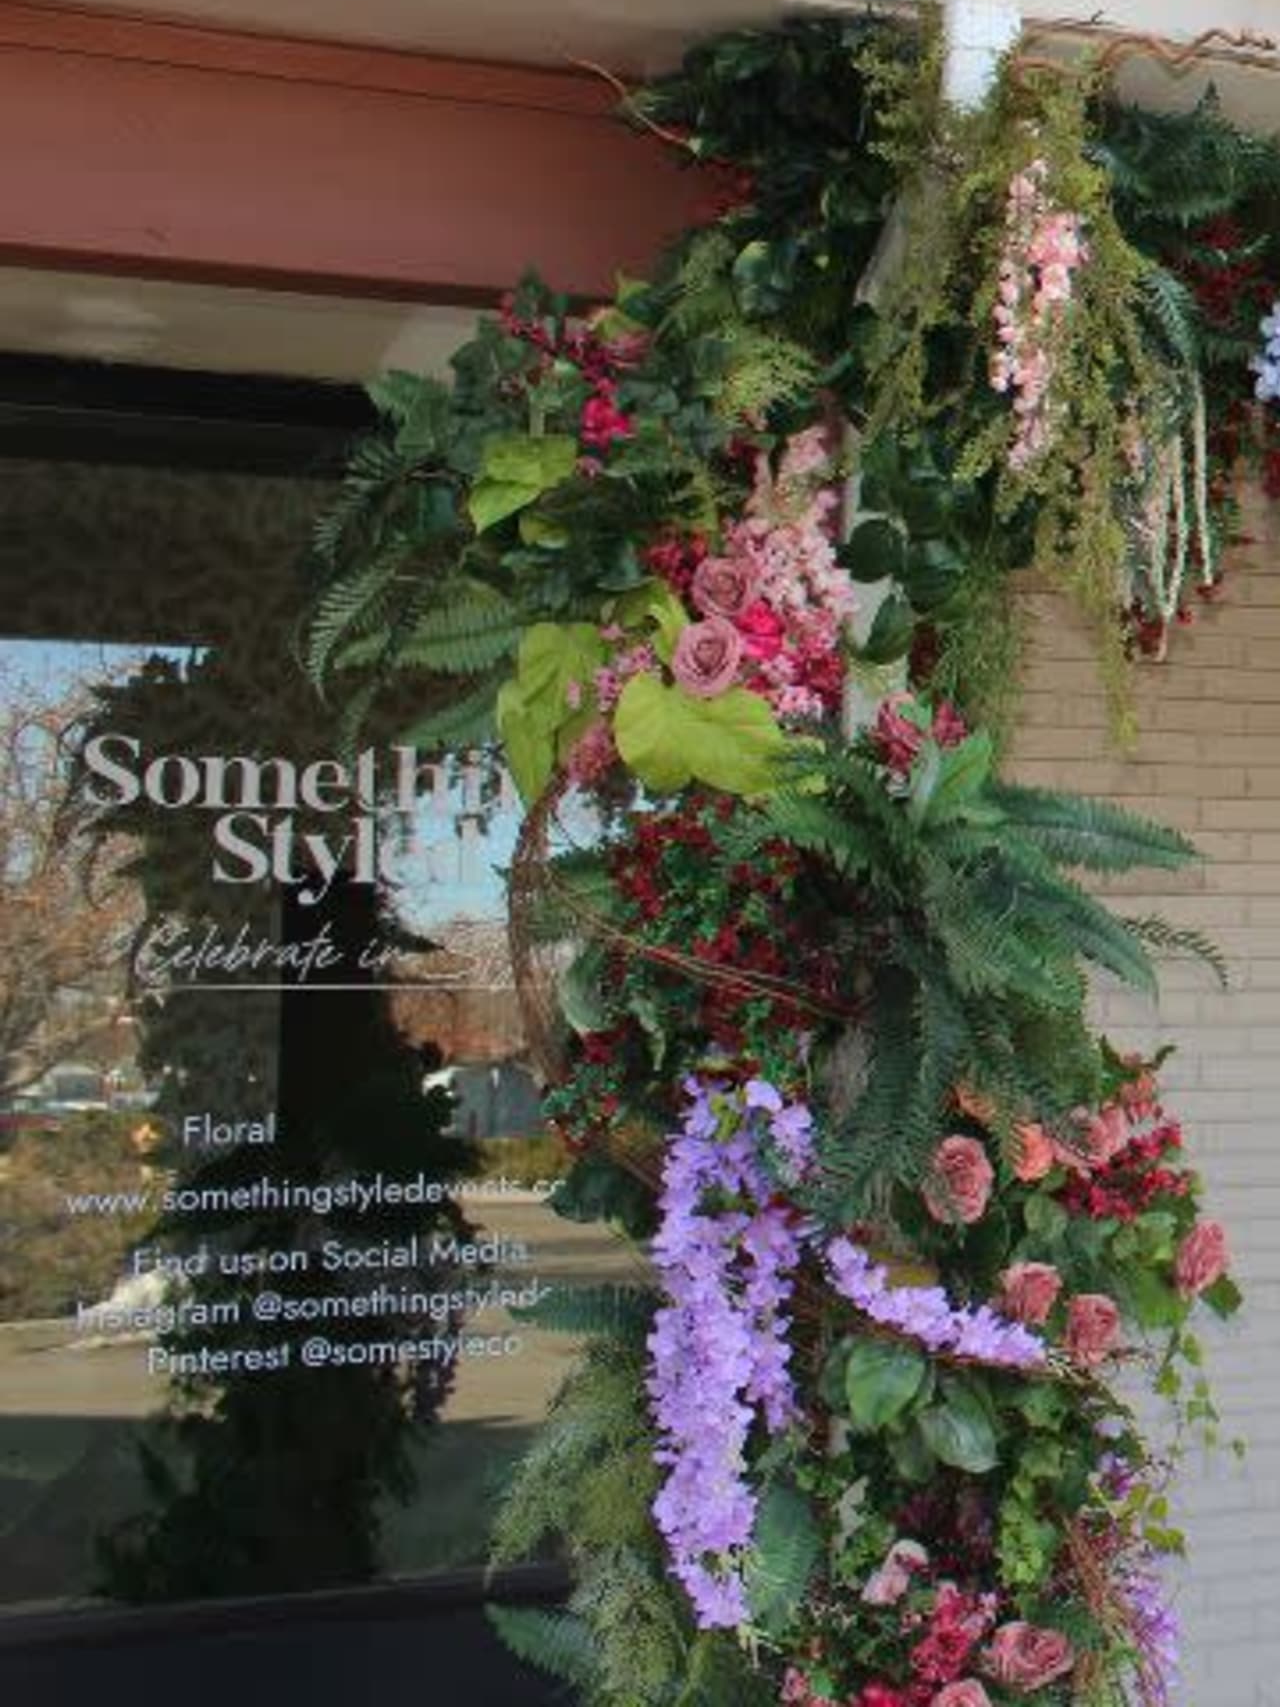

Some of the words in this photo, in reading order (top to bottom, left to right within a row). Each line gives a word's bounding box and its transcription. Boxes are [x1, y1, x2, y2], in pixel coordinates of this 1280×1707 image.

[134, 914, 344, 981] Celebrate
[182, 1111, 276, 1146] Floral
[133, 1244, 207, 1276] Find
[219, 1251, 258, 1275] us
[269, 1249, 308, 1272] on
[322, 1235, 418, 1271] Social
[429, 1234, 530, 1266] Media
[76, 1297, 239, 1333] Instagram
[148, 1344, 289, 1374] Pinterest
